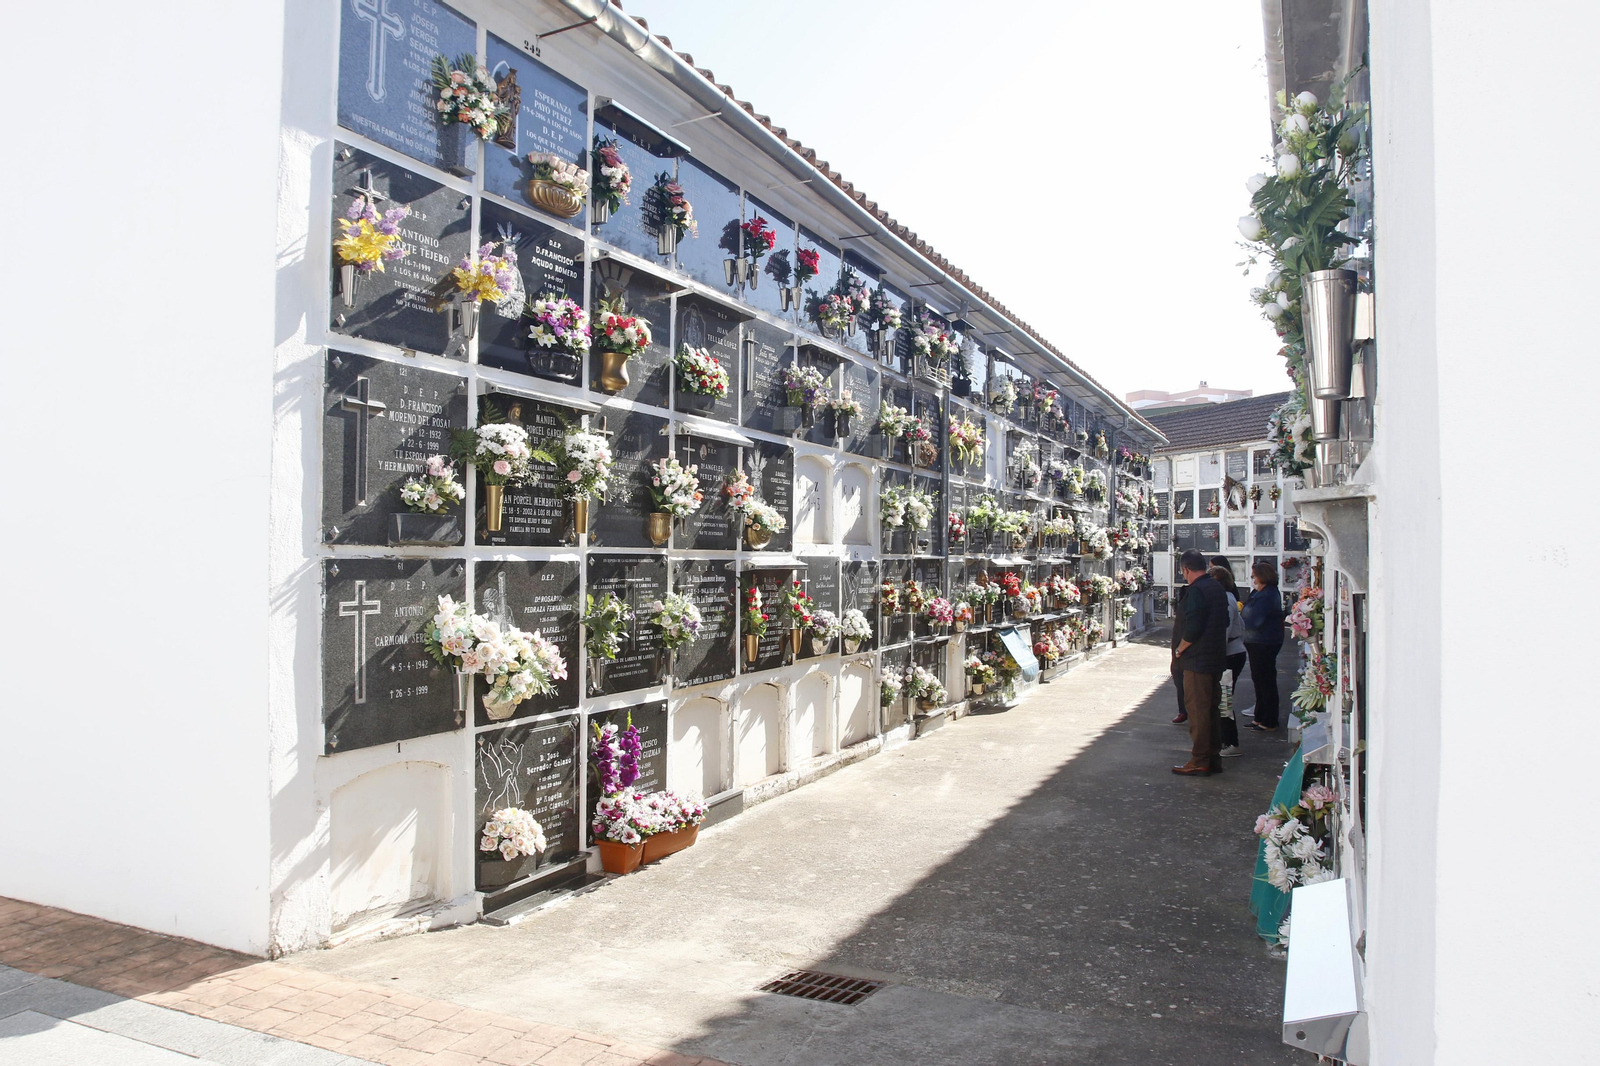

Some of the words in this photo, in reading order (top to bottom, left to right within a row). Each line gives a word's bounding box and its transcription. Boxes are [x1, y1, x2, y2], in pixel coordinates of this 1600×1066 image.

[412, 13, 439, 35] JOSEFA
[410, 24, 439, 48] VERGEL
[409, 38, 439, 59] SEDANO
[524, 40, 541, 58] 242
[414, 78, 432, 94] JUAN
[409, 89, 436, 110] JIRONA
[535, 89, 572, 116] ESPERANZA
[408, 101, 436, 122] VERGEL
[534, 100, 550, 115] PAYO
[552, 110, 572, 127] PEREZ
[352, 112, 381, 133] VUESTRA
[382, 126, 405, 144] FAMILIA
[405, 138, 414, 148] NO
[415, 142, 423, 152] OS
[424, 146, 444, 162] OLVIDA
[406, 124, 418, 136] LOS
[551, 120, 562, 130] LOS
[569, 129, 583, 141] AÑOS
[526, 130, 537, 140] LOS
[538, 136, 549, 146] QUE
[550, 141, 556, 149] TE
[534, 142, 542, 151] NO
[402, 228, 439, 248] ANTONIO
[419, 247, 449, 265] TEJERO
[400, 268, 411, 278] LOS
[421, 273, 437, 285] AÑOS
[555, 264, 578, 279] ROMERO
[402, 282, 420, 293] ESPOSA
[412, 302, 434, 313] OLVIDAN
[388, 410, 418, 424] MORENO
[418, 417, 429, 426] DEL
[535, 415, 556, 426] MANUEL
[526, 425, 544, 436] PORCEL
[395, 449, 403, 459] TU
[405, 451, 427, 461] ESPOSA
[384, 461, 414, 473] HERMANO
[415, 465, 424, 474] NO
[513, 496, 532, 505] PORCEL
[397, 562, 404, 570] 61
[394, 606, 424, 617] ANTONIO
[524, 606, 546, 614] PEDRAZA
[543, 626, 560, 634] RAFAEL
[374, 635, 408, 647] CARMONA
